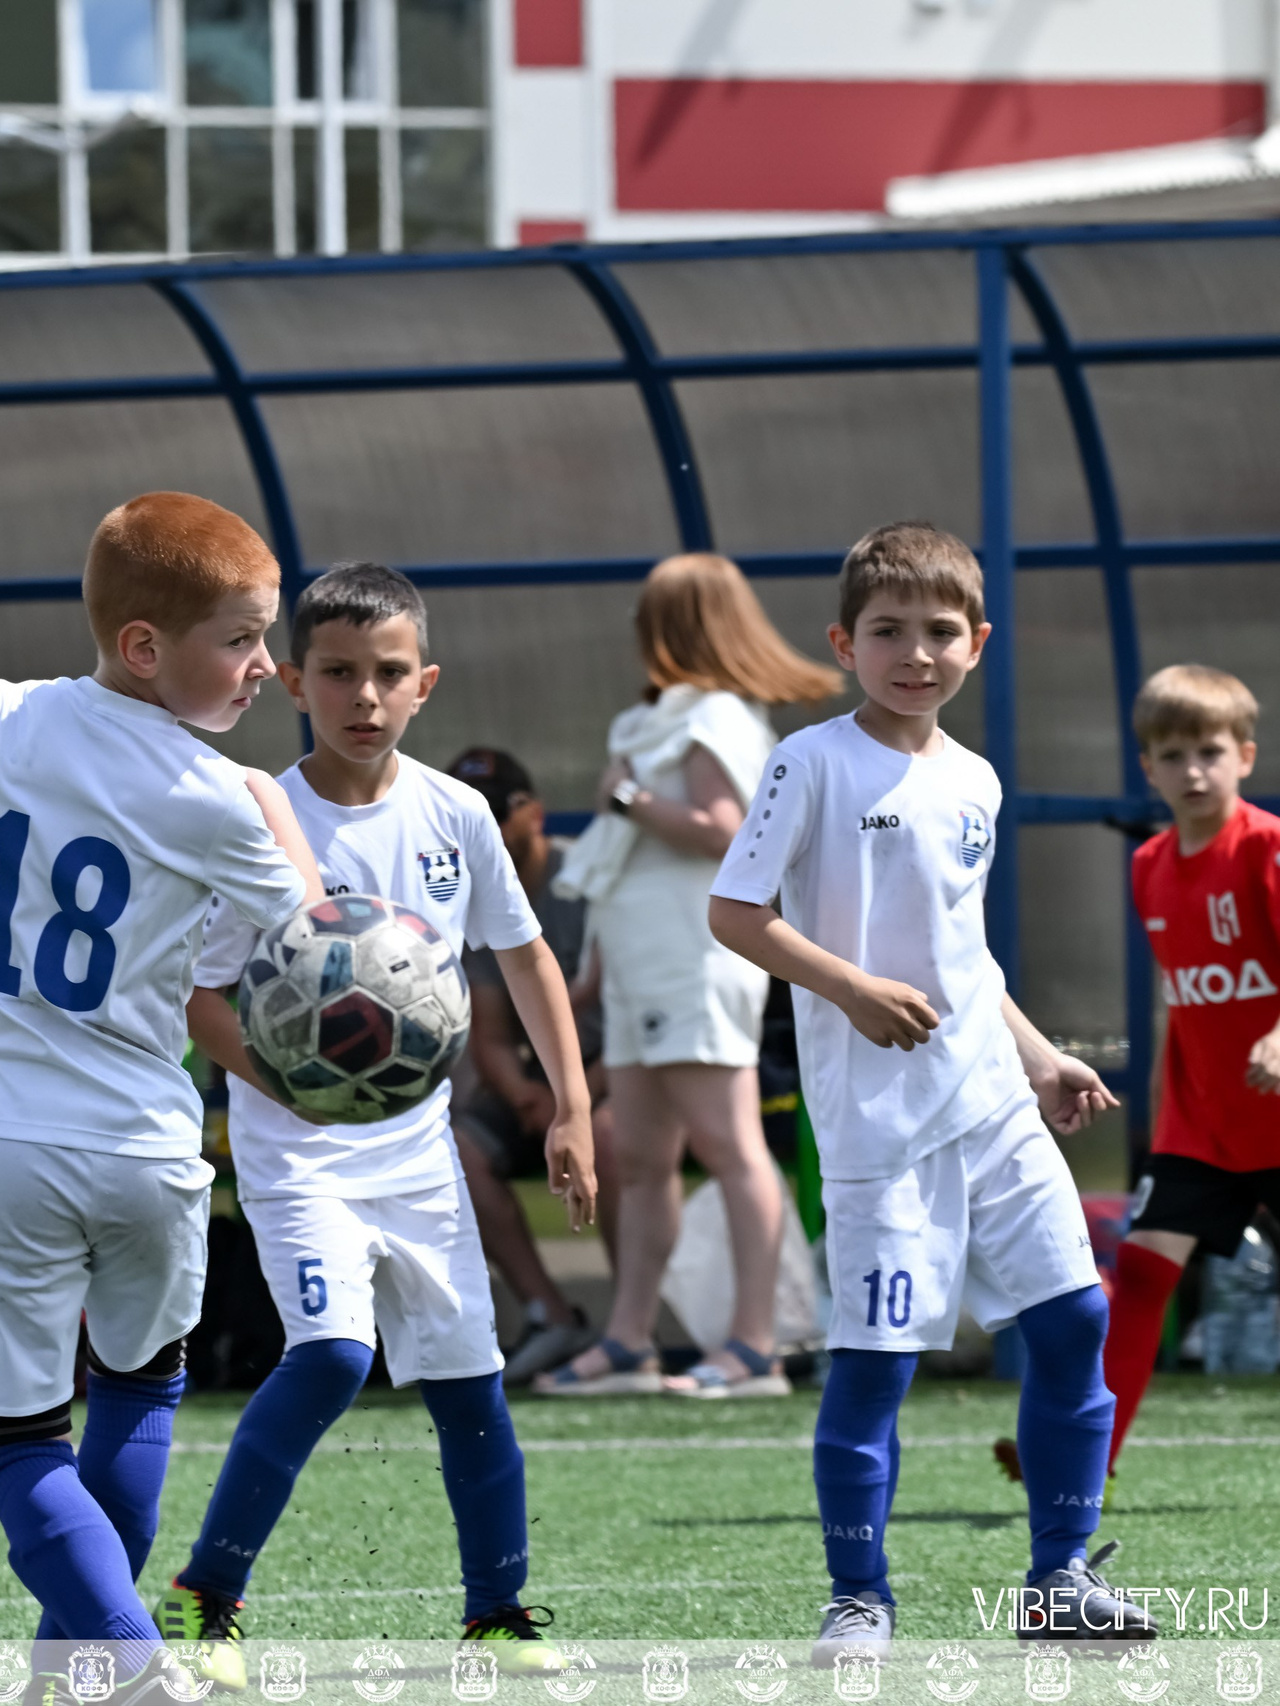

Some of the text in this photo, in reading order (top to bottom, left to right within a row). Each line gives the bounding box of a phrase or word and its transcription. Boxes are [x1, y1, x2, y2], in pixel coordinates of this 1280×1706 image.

[860, 815, 900, 831] JAKO
[325, 885, 350, 897] KO
[297, 1258, 327, 1317] 5
[863, 1269, 912, 1328] 10
[1052, 1493, 1105, 1509] JAKO
[823, 1522, 873, 1542] JAKO
